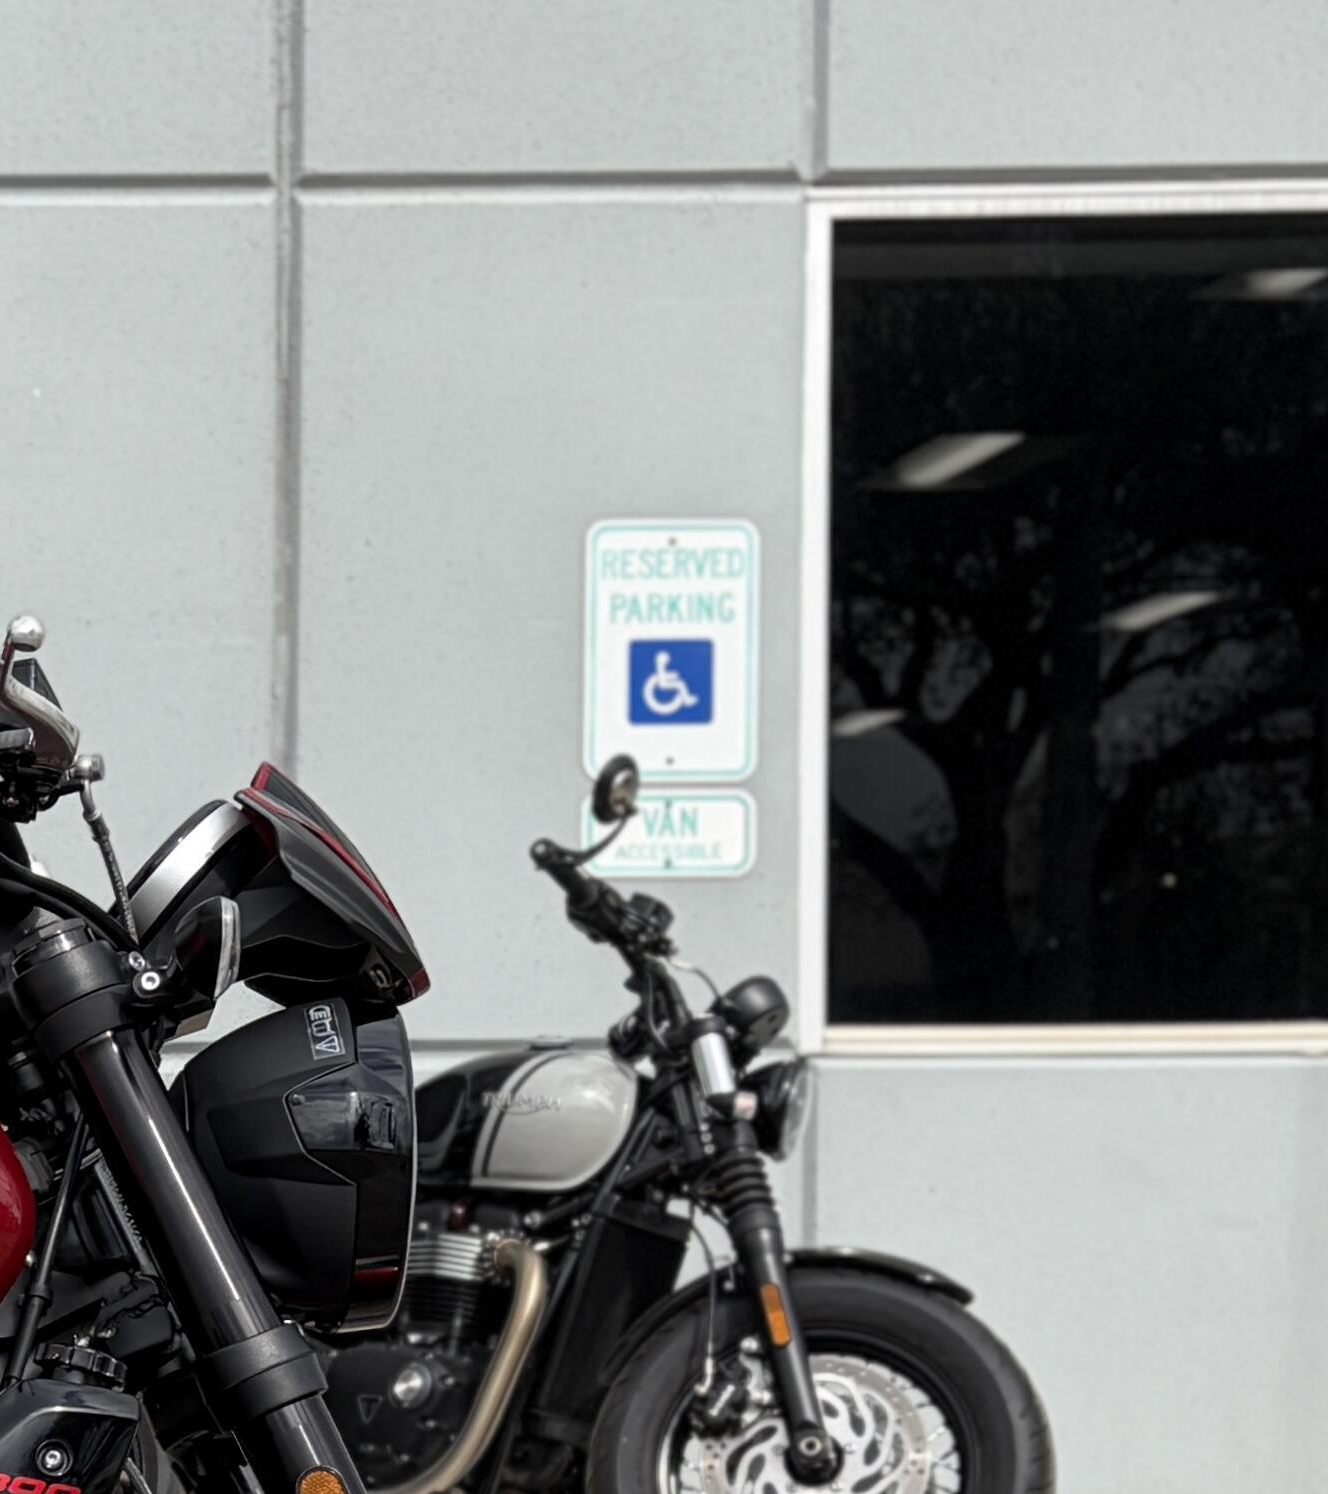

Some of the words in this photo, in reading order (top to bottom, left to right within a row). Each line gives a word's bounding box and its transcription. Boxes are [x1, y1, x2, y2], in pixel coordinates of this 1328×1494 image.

[601, 548, 745, 579] RESERVED
[608, 592, 736, 624] PARKING
[642, 807, 699, 838] VAN
